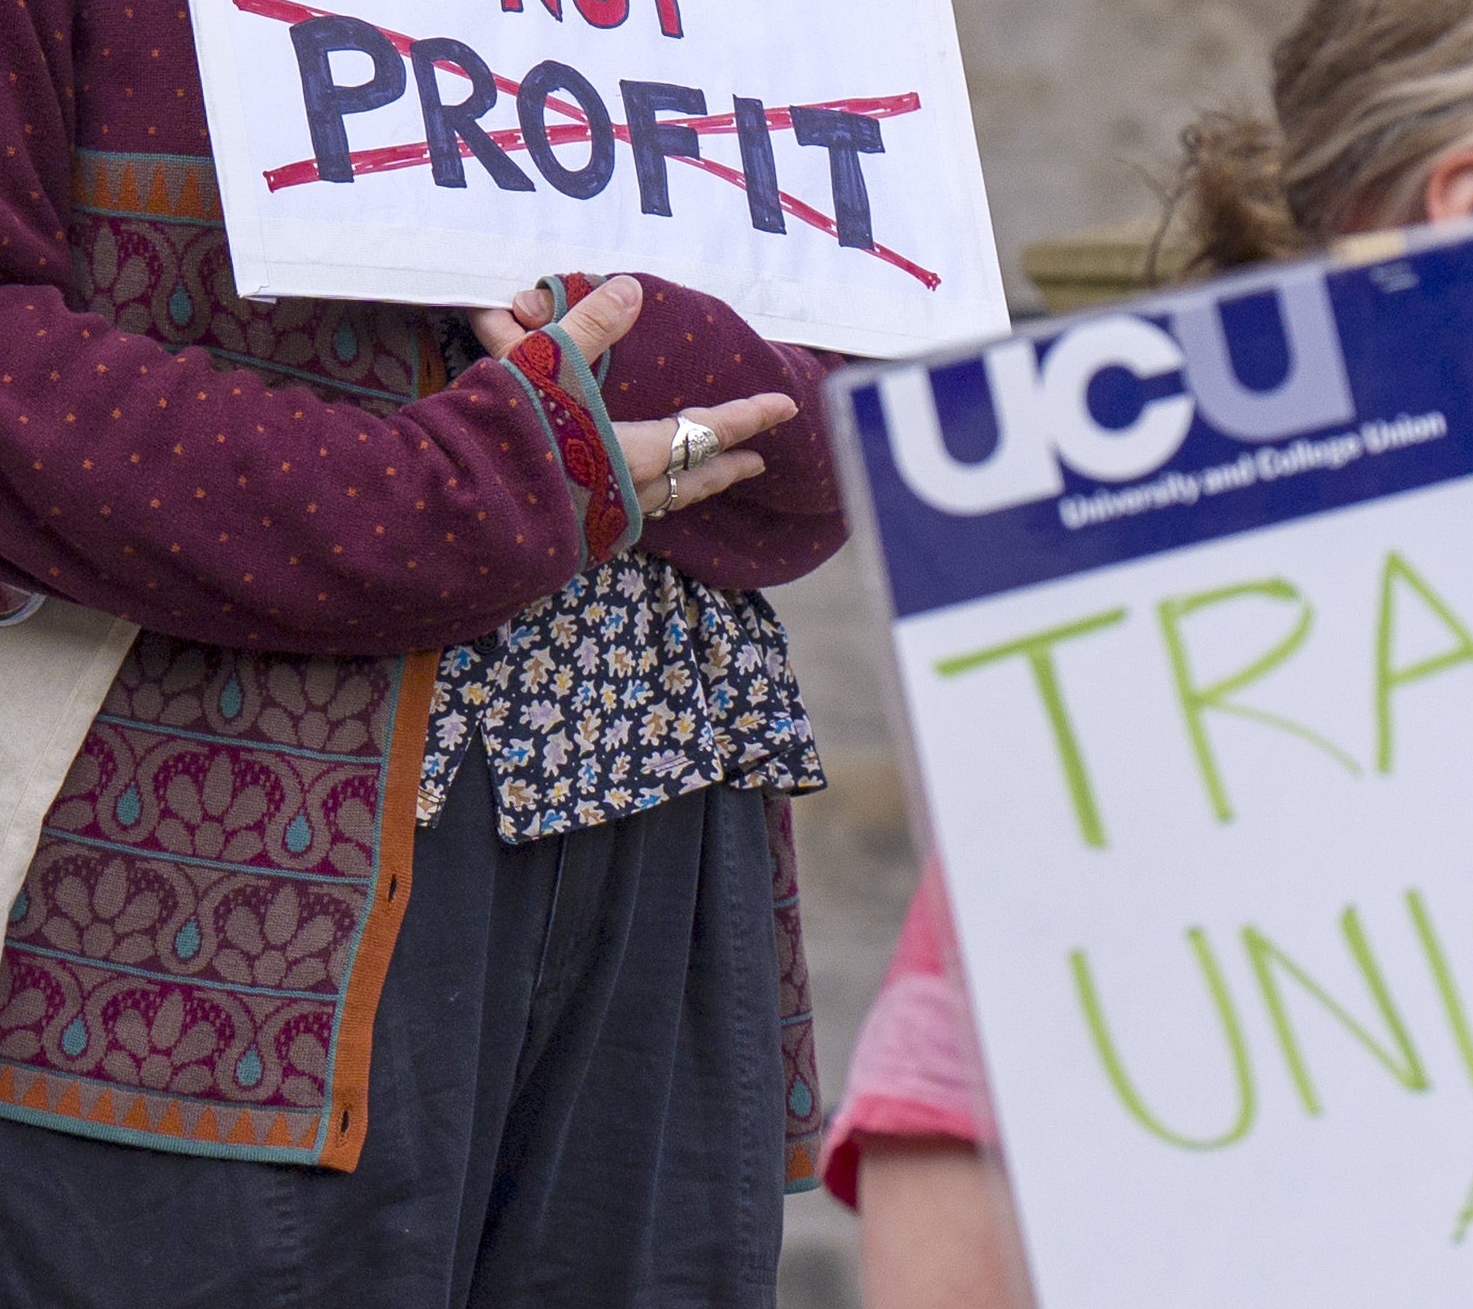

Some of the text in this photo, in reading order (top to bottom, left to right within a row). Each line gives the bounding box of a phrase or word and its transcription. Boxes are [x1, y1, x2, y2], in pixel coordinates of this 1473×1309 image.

[290, 15, 887, 251] PROFIT
[878, 265, 1355, 516] UCU
[1059, 410, 1447, 529] University and College Union
